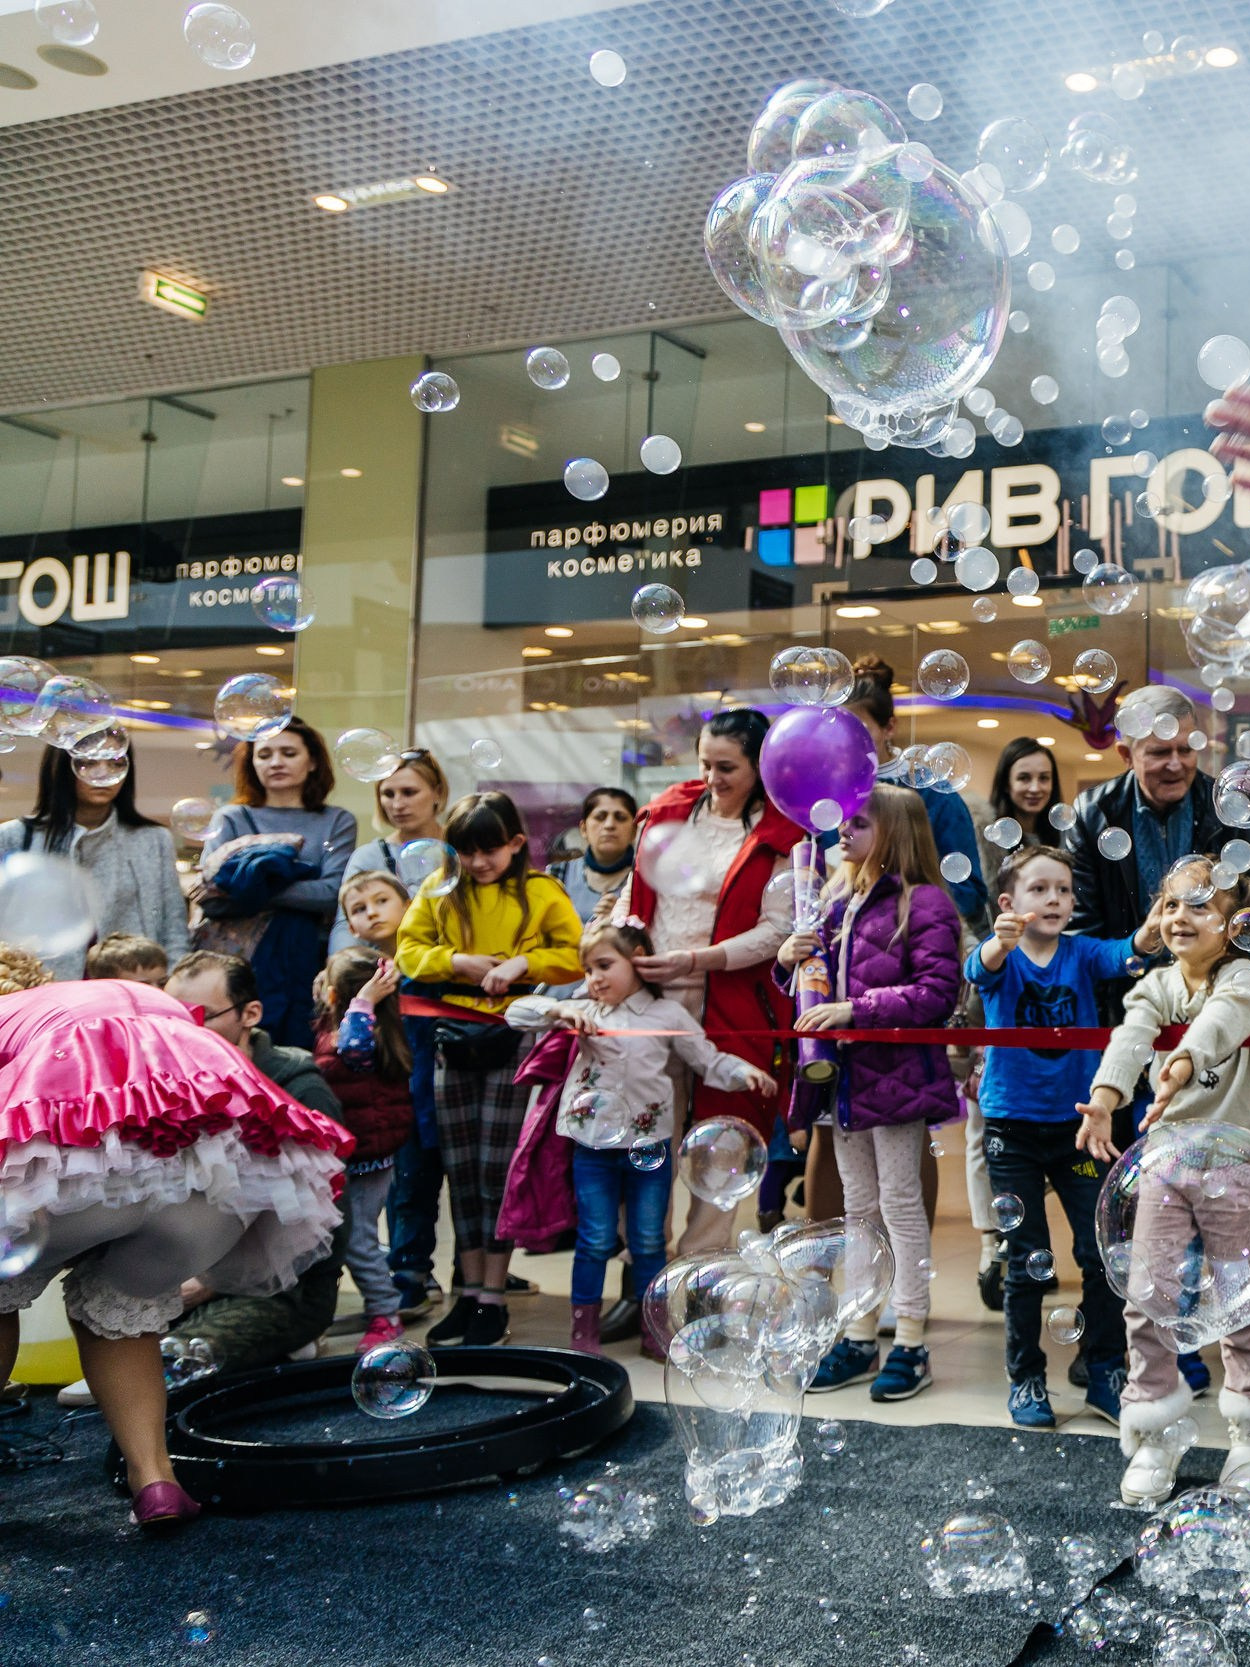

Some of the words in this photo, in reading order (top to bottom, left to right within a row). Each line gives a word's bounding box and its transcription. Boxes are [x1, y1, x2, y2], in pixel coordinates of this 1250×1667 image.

[853, 463, 1061, 560] РИВ
[530, 513, 723, 550] парфюмерия
[547, 547, 702, 579] косметика
